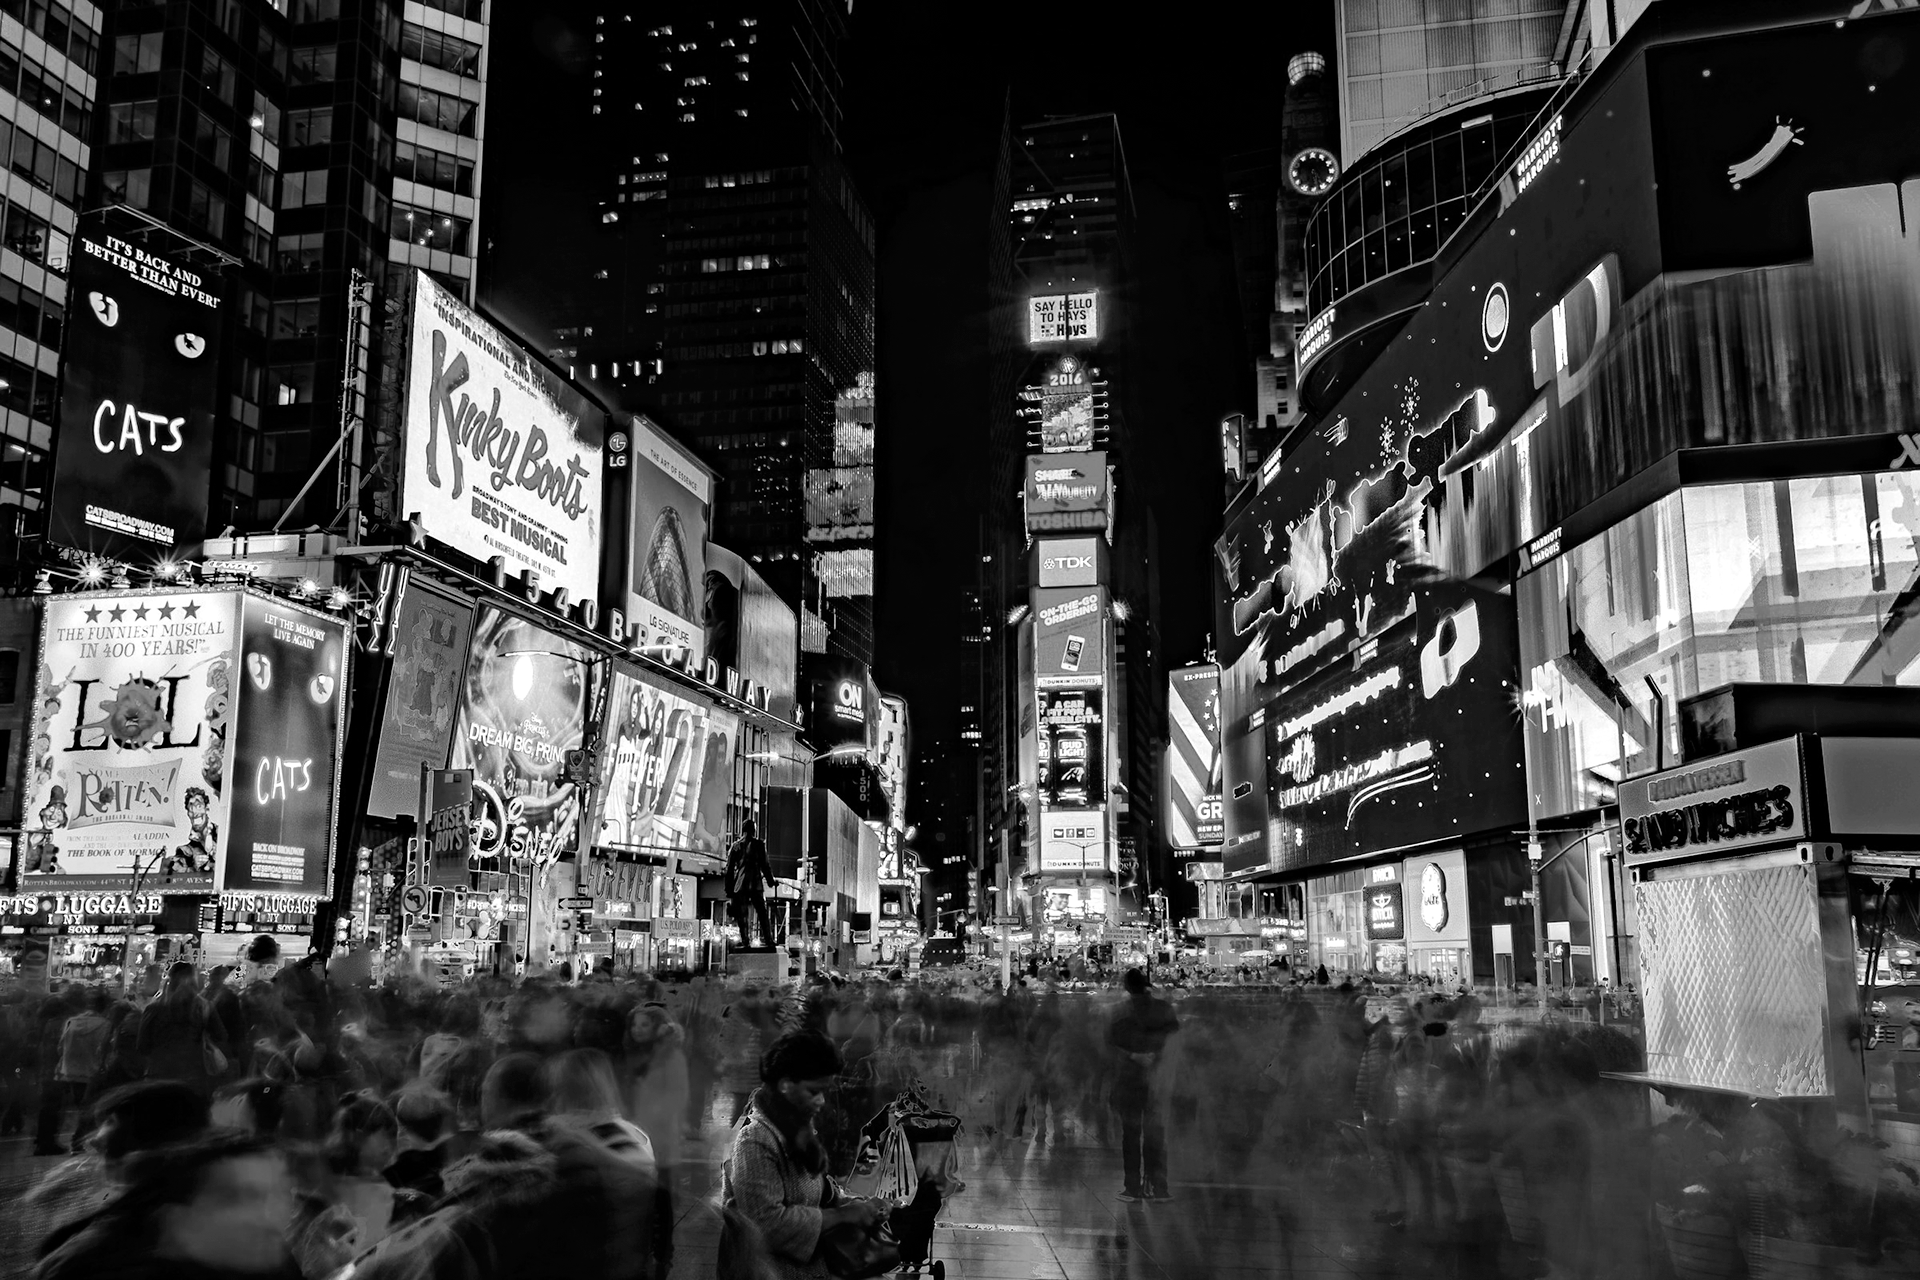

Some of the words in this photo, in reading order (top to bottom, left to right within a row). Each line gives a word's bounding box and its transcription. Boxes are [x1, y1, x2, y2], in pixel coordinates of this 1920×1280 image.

[1516, 114, 1563, 176] MARRIOTT
[1518, 140, 1559, 194] MARQUIS
[106, 235, 133, 257] IT'S
[135, 248, 171, 274] BACK
[173, 267, 202, 287] AND
[140, 265, 179, 291] THAN
[1034, 301, 1056, 312] SAY
[1059, 298, 1092, 311] HELLO
[1041, 312, 1054, 323] TO
[1058, 310, 1087, 322] HAYS
[512, 361, 531, 383] AND
[1050, 373, 1083, 386] 2016
[1043, 384, 1092, 395] TOSHIBA
[93, 399, 187, 456] CATS
[426, 329, 515, 500] Kinky
[515, 424, 591, 521] Boots
[609, 455, 627, 467] LG
[650, 449, 660, 462] THE
[660, 458, 670, 470] ART
[670, 465, 678, 475] OF
[678, 470, 698, 492] ESSENCE
[86, 504, 175, 538] CATSBROADWAY.COM
[471, 496, 509, 534] BEST
[510, 517, 568, 566] MUSICAL
[1028, 511, 1107, 531] TOSHIBA
[1531, 526, 1563, 553] MARRIOTT
[1054, 556, 1093, 569] TDK
[1531, 539, 1561, 565] MARQUIS
[1039, 594, 1098, 619] ON-THE-GO
[1044, 603, 1098, 626] ORDERING
[57, 628, 84, 641] THE
[87, 624, 158, 641] FUNNIEST
[161, 621, 225, 638] MUSICAL
[265, 613, 279, 626] LET
[279, 617, 295, 631] THE
[295, 621, 325, 641] MEMORY
[488, 555, 598, 630] 1540
[610, 608, 772, 712] BROADWAY
[649, 613, 658, 627] LG
[657, 618, 690, 645] SIGNATURE
[273, 627, 291, 642] LIVE
[291, 633, 315, 649] AGAIN
[80, 642, 99, 658] IN
[103, 641, 135, 658] 400
[839, 682, 862, 709] ON
[1055, 700, 1062, 708] A
[1063, 700, 1085, 708] CAN
[835, 704, 851, 714] smart
[1064, 708, 1084, 716] FOR
[1085, 707, 1093, 715] A
[1041, 716, 1075, 725] QUEEN
[469, 722, 512, 750] DREAM
[513, 735, 534, 758] BIG,
[1061, 741, 1082, 749] BUD
[1060, 749, 1085, 757] LIGHT
[256, 757, 312, 806] CATS
[133, 832, 170, 840] ALADDIN
[435, 829, 463, 851] BOYS
[67, 849, 85, 857] THE
[87, 849, 112, 857] BOOK
[114, 849, 125, 857] OF
[55, 896, 163, 914] LUGGAGE
[219, 893, 255, 911] GIFTS
[264, 896, 317, 914] LUGGAGE
[48, 914, 53, 925] I
[63, 914, 84, 925] NY
[267, 913, 280, 923] NY
[276, 924, 296, 932] SONY
[68, 926, 99, 934] SONY
